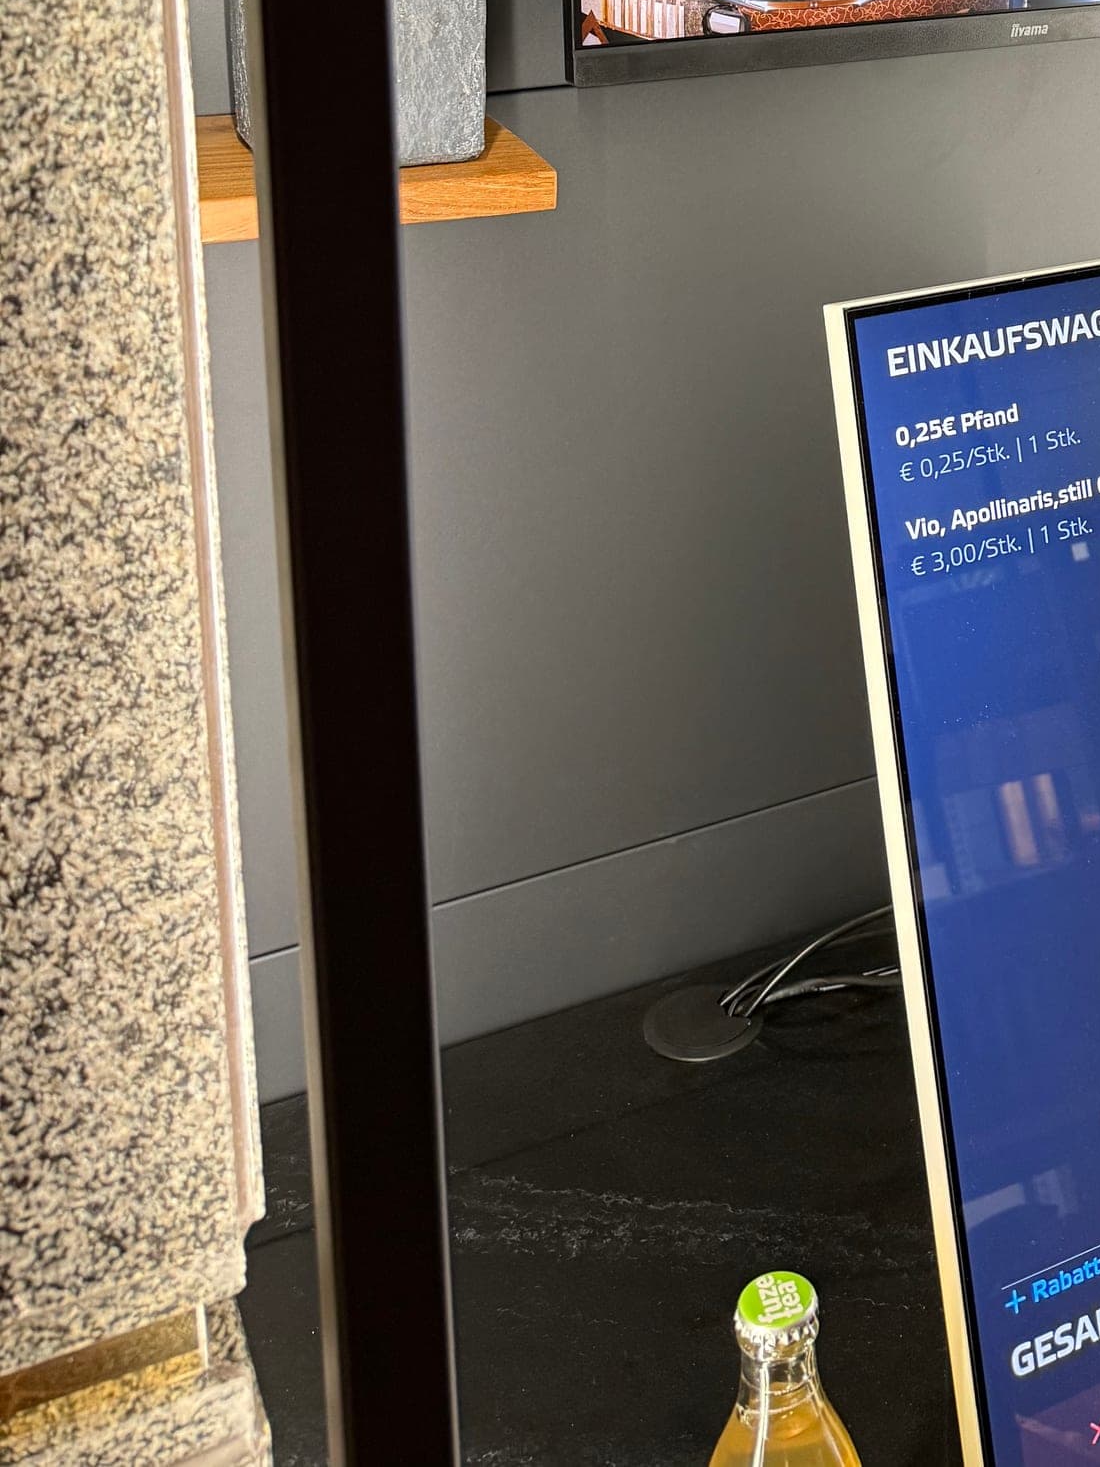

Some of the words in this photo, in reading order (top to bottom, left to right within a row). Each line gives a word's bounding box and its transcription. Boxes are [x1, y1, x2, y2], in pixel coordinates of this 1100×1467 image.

[1010, 23, 1049, 38] iiyama
[895, 415, 957, 449] 0,25€
[960, 402, 1019, 434] Pfand
[899, 461, 915, 482] €
[920, 442, 1011, 480] 0,25/Stk.
[1028, 435, 1038, 454] 1
[1045, 427, 1082, 450] Stk.
[904, 517, 947, 540] Vio,
[950, 478, 1093, 531] Apollinaris,still
[910, 555, 927, 576] €
[930, 533, 1022, 573] 3,00/Stk.
[1040, 525, 1049, 544] 1
[1057, 516, 1094, 540] Stk.
[777, 1280, 804, 1319] tea
